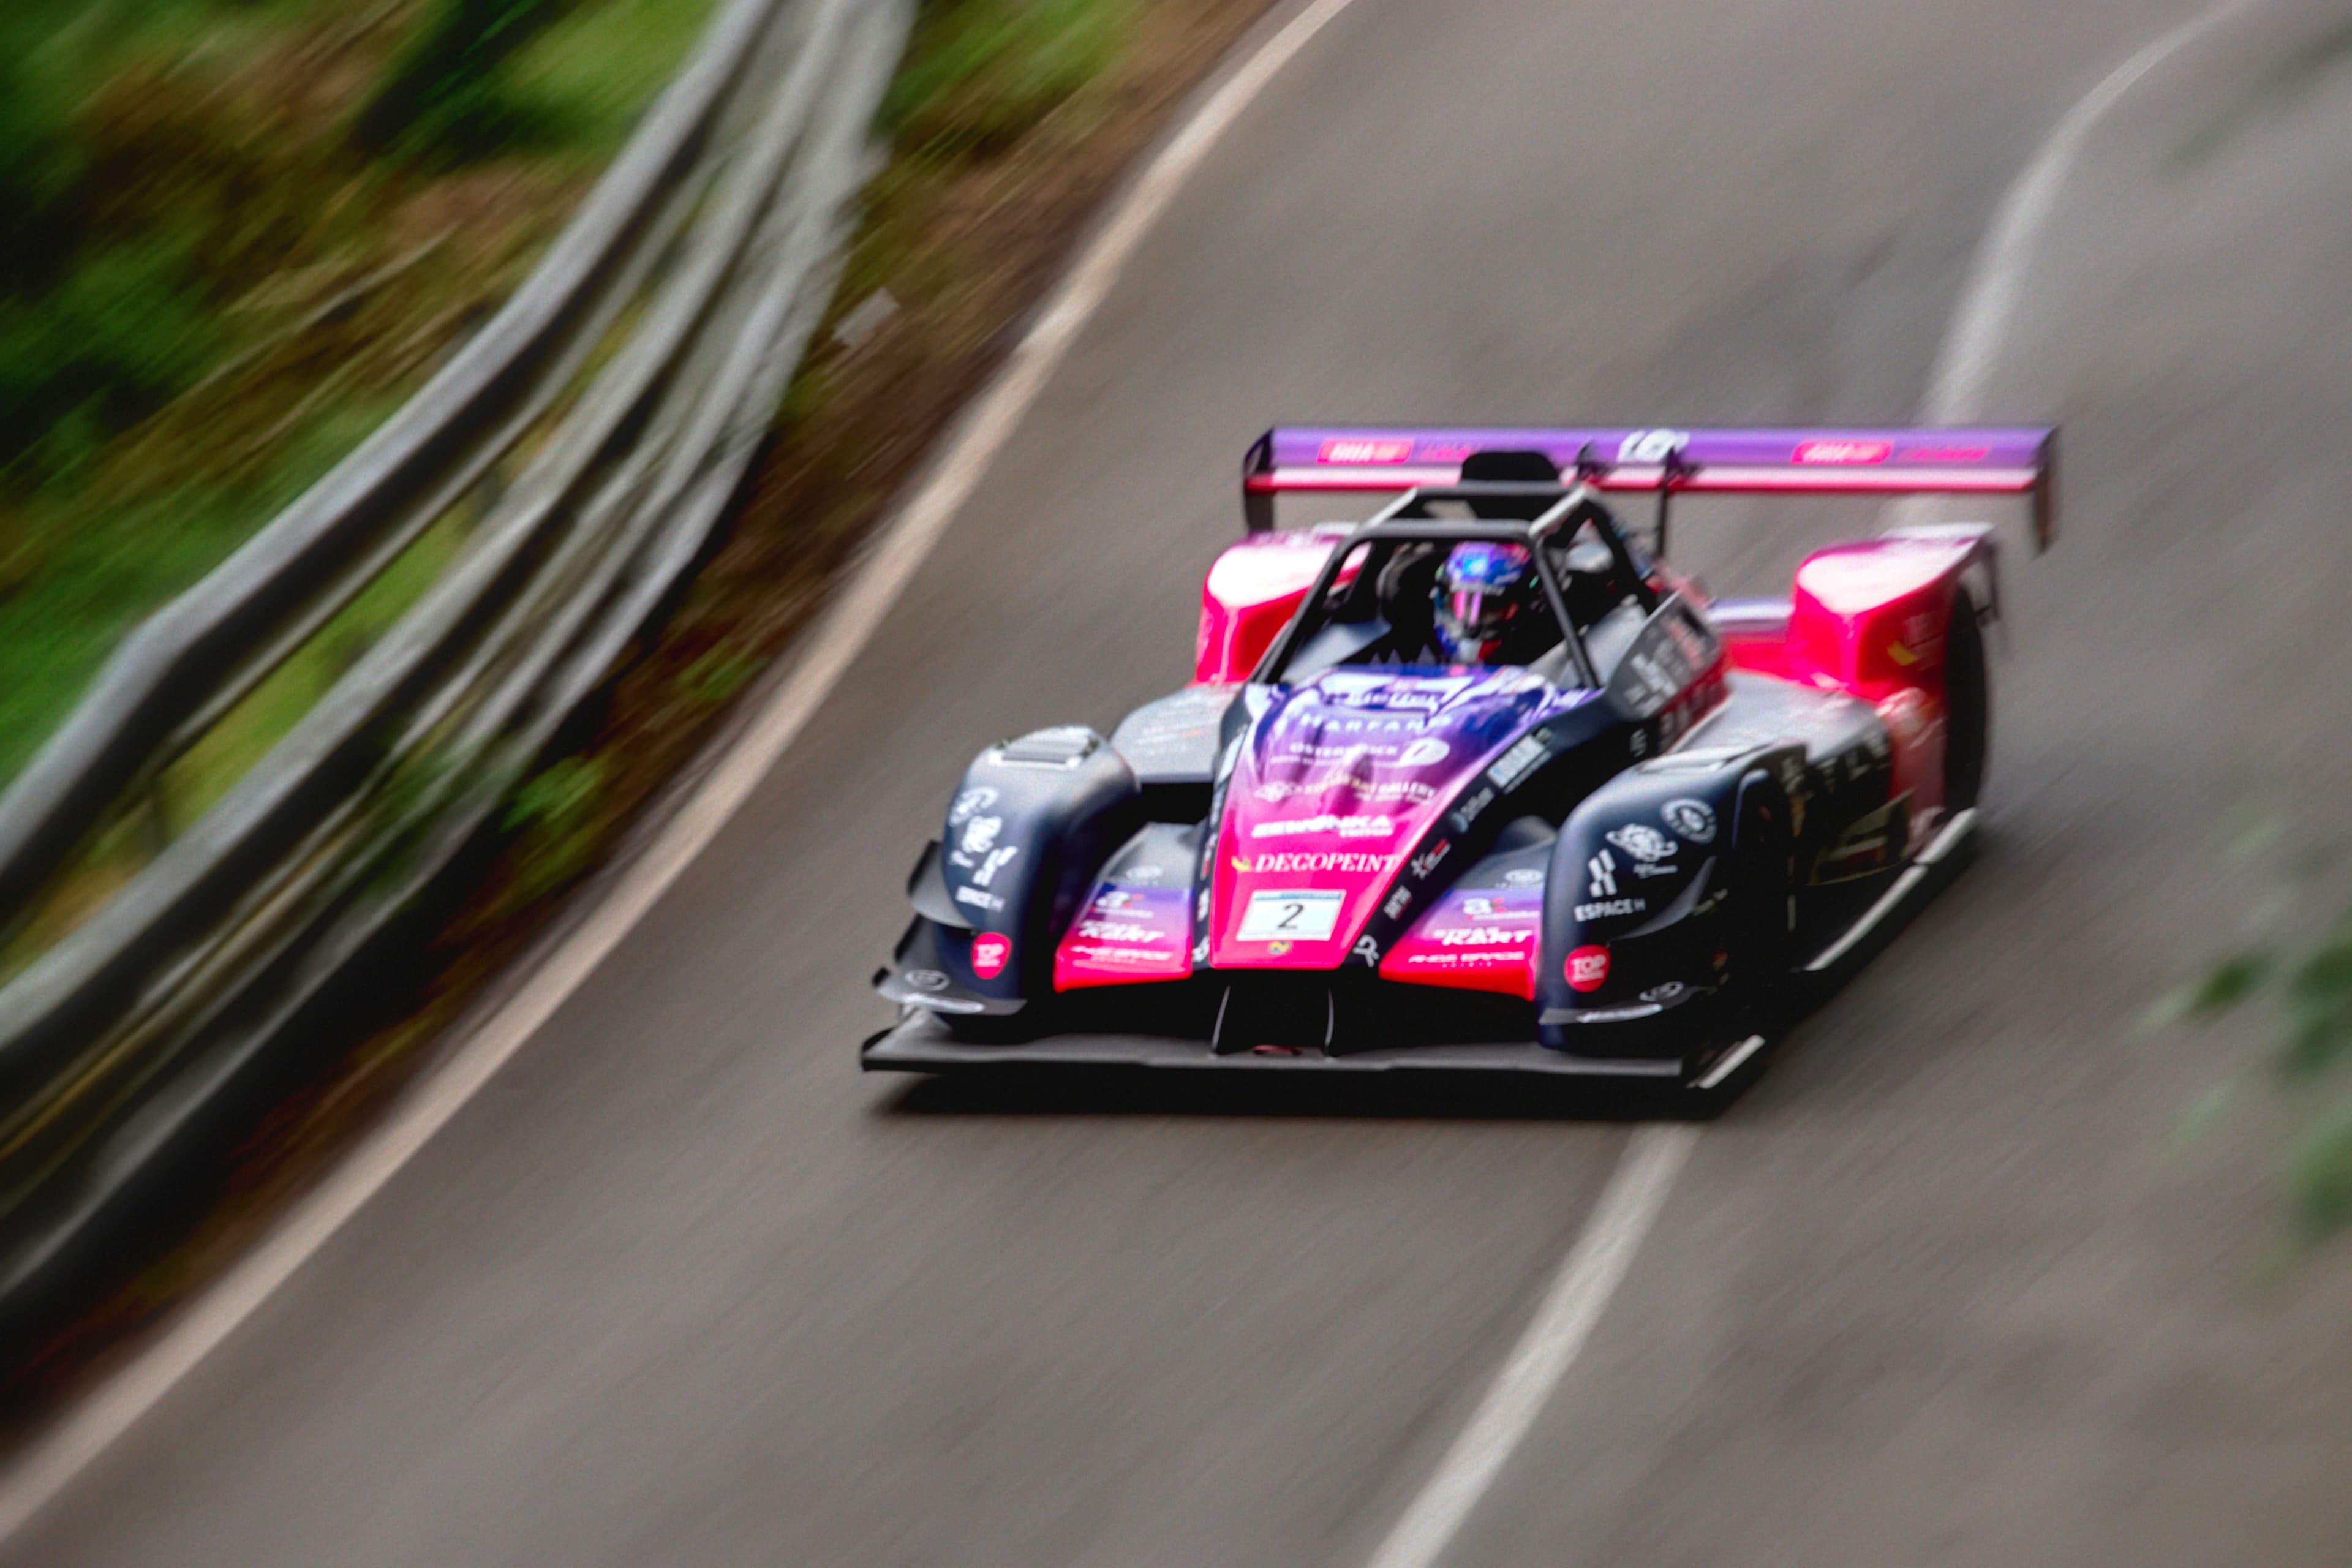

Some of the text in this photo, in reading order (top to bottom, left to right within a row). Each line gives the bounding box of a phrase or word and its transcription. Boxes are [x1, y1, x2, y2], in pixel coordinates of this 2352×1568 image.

[1256, 852, 1400, 872] DECOPEINT
[1277, 903, 1305, 929] 2
[1574, 899, 1633, 922] ESPACE
[1570, 954, 1607, 974] TOP
